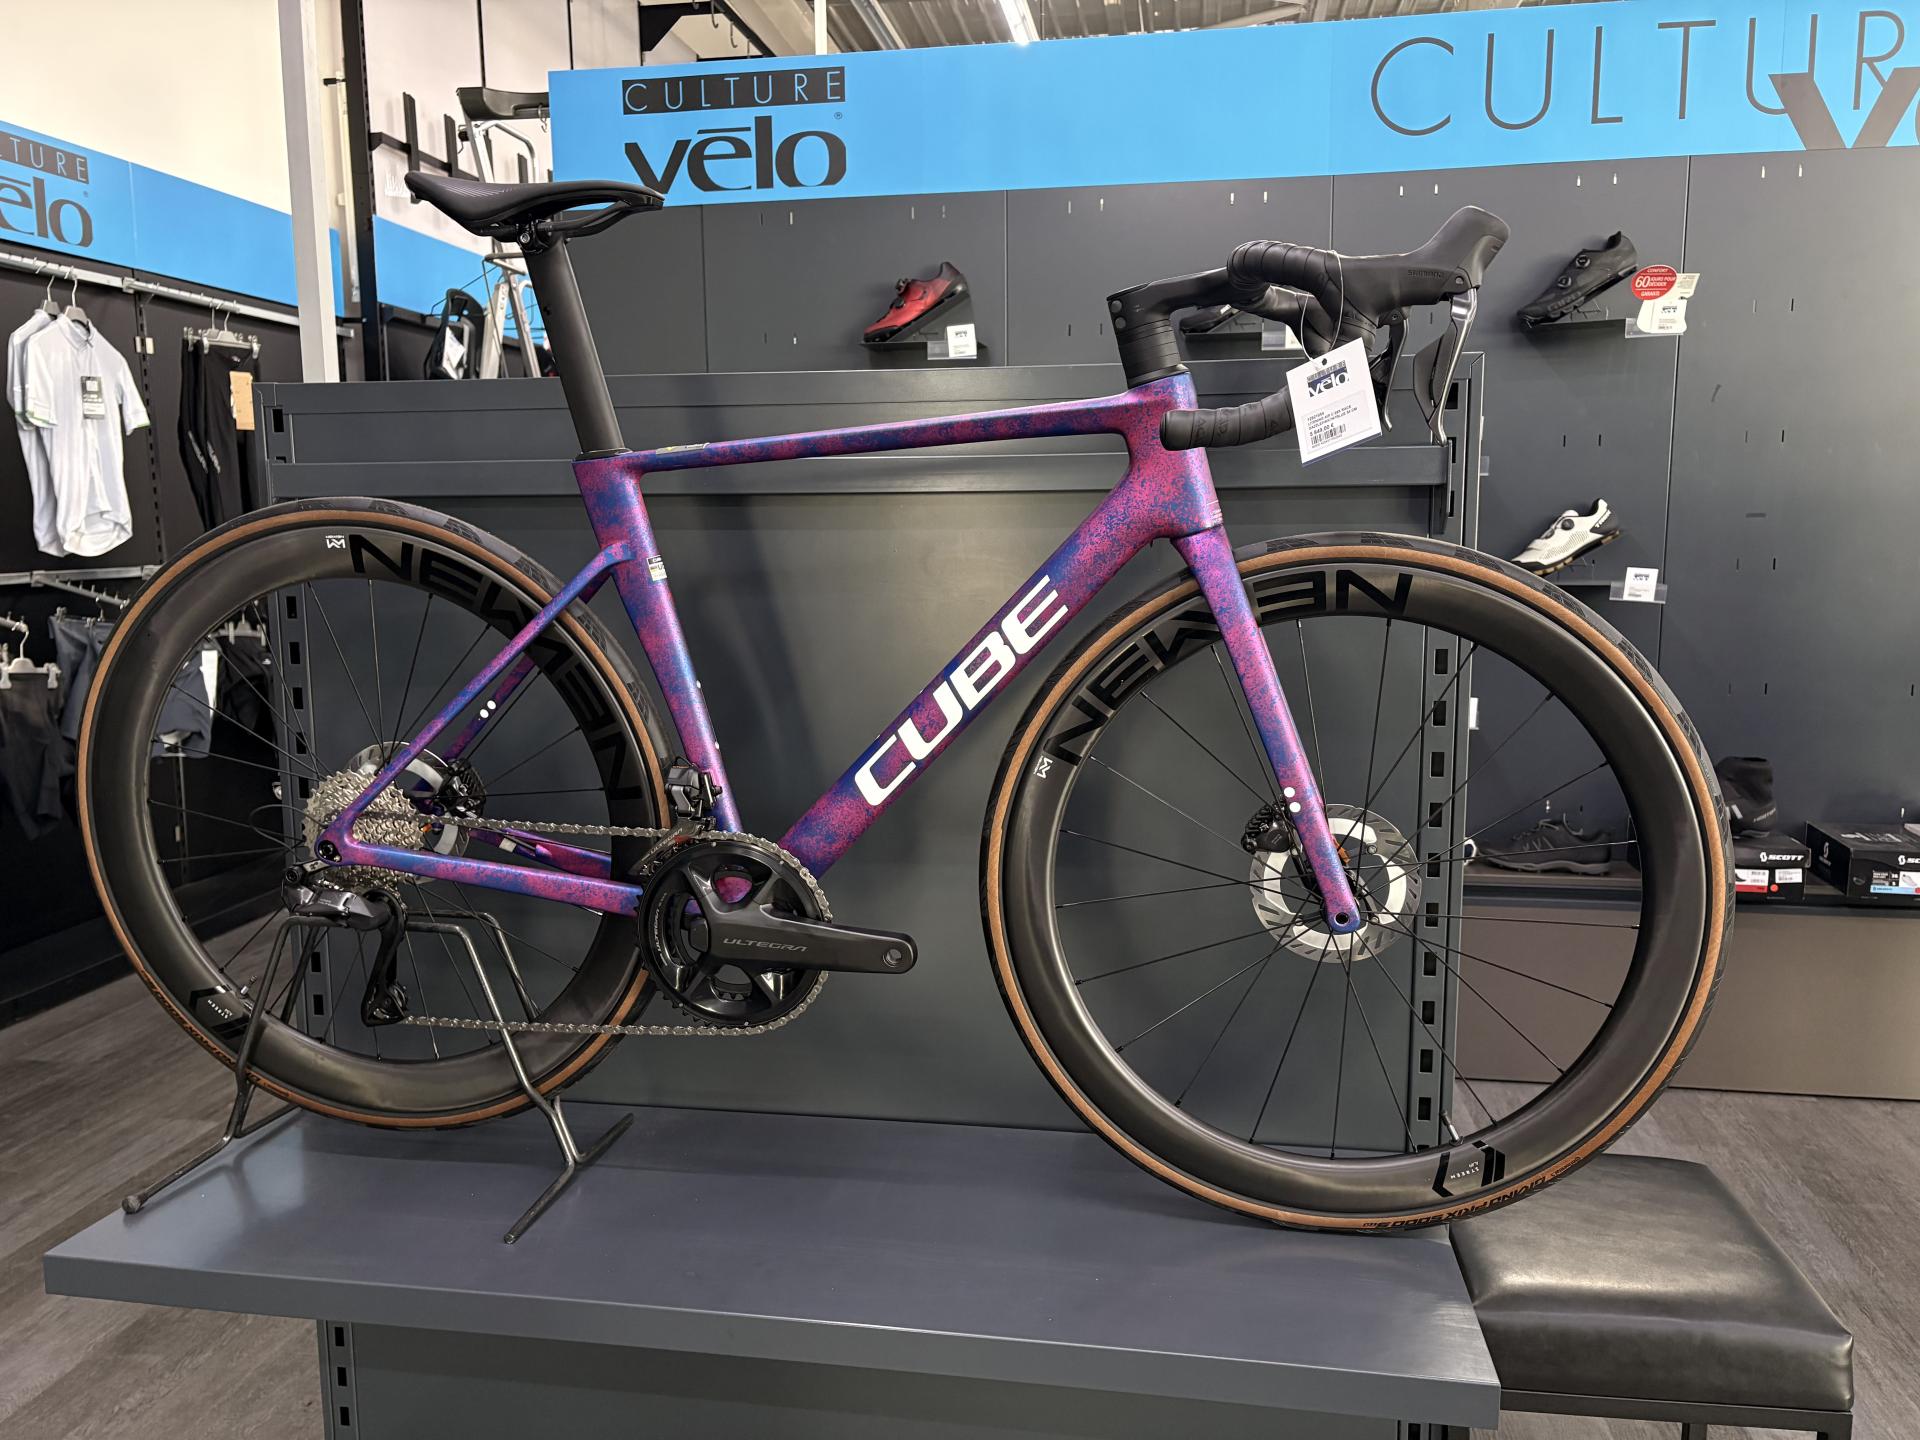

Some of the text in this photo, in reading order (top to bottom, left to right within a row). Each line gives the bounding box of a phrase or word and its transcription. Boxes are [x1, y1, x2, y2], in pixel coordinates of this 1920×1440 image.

[624, 71, 841, 112] CULTURE
[1635, 275, 1651, 288] 60
[854, 574, 1069, 806] CUBE
[723, 937, 808, 952] ULTEGRA
